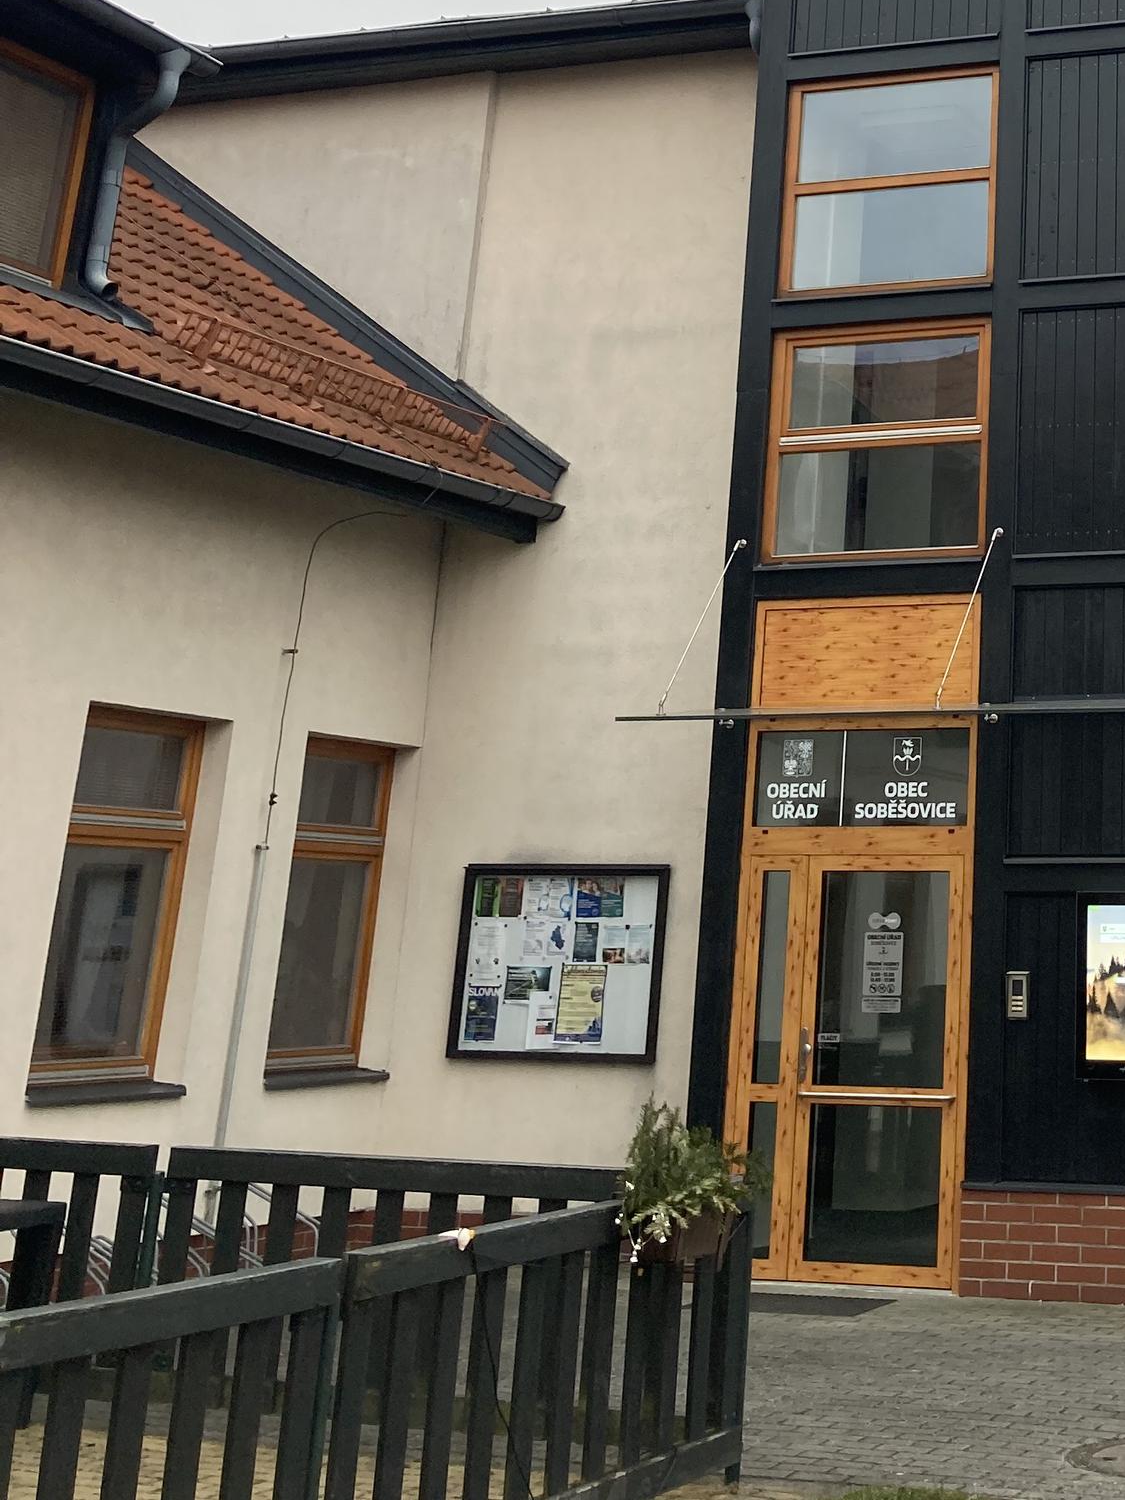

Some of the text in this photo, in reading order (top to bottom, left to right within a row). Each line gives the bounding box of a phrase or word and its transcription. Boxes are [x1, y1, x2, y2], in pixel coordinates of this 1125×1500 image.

[766, 779, 828, 799] OBECNÍ
[884, 781, 928, 798] OBEC
[771, 800, 819, 819] ÚŘAD
[854, 799, 956, 819] SOBĚŠOVICE
